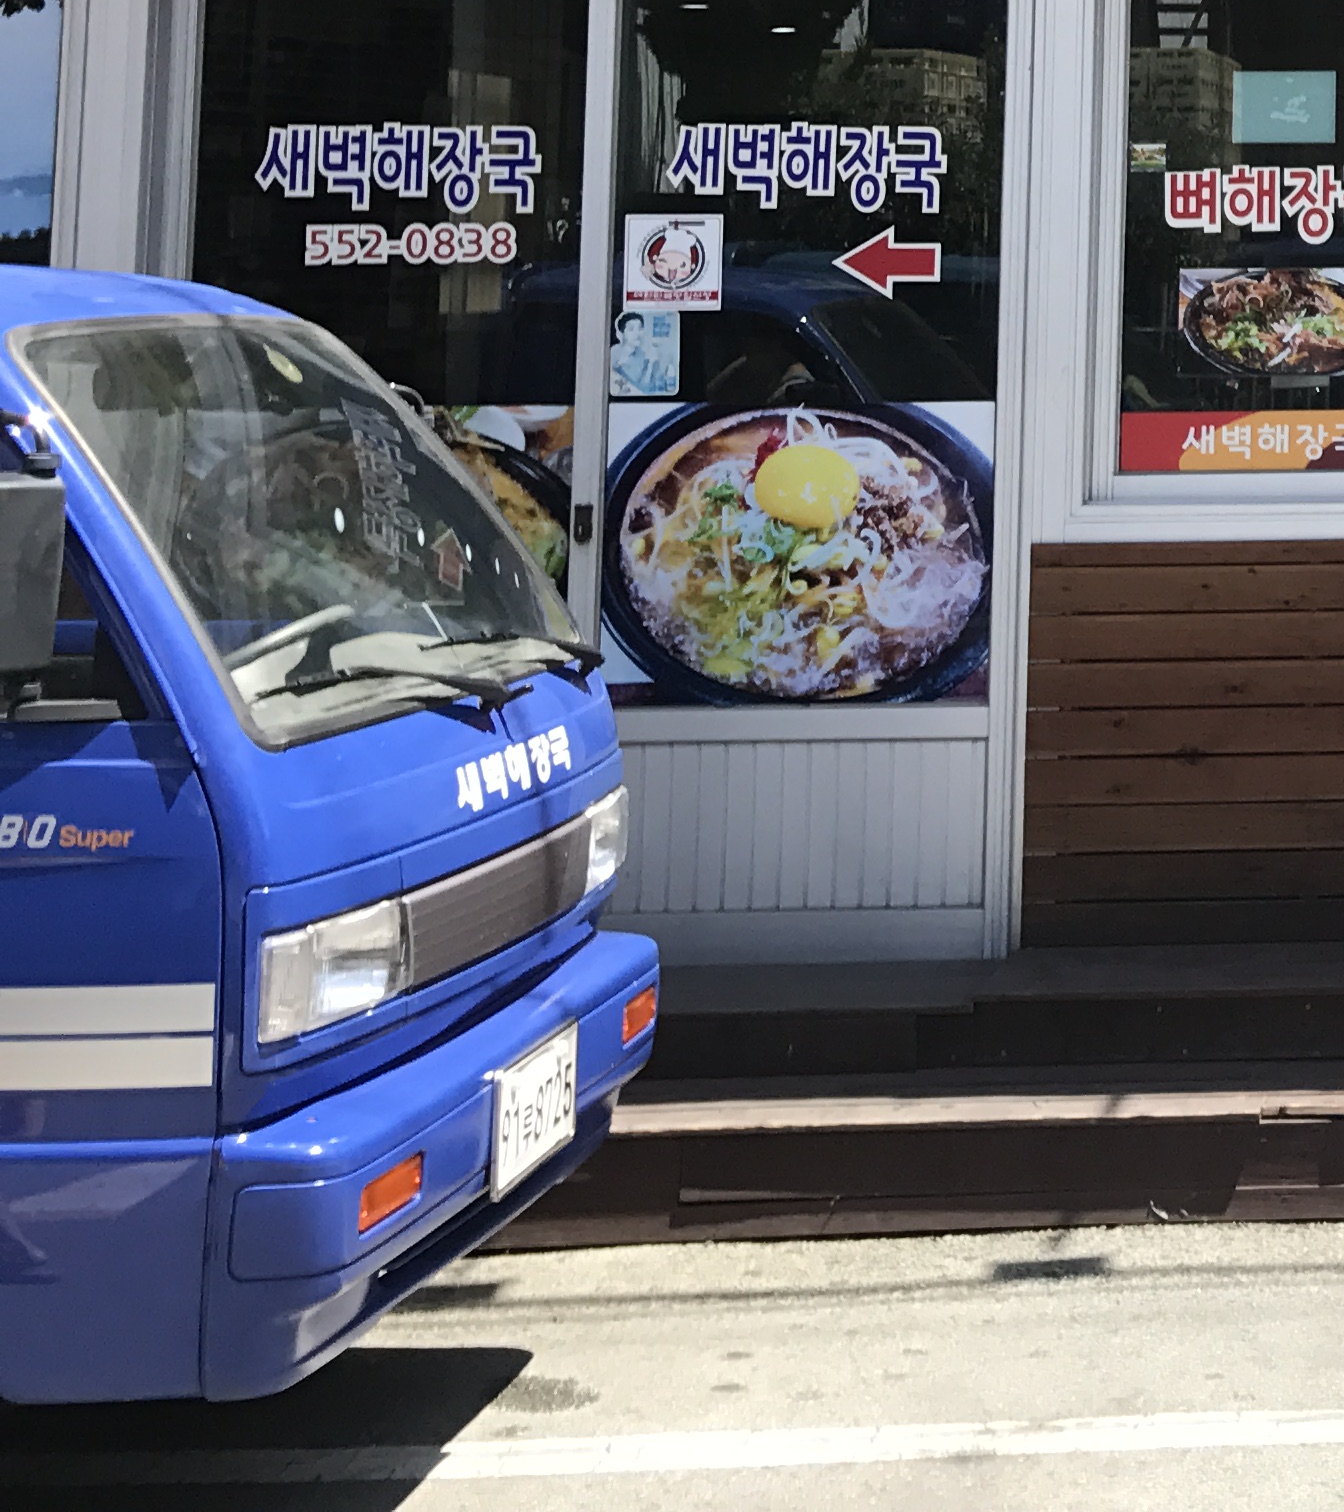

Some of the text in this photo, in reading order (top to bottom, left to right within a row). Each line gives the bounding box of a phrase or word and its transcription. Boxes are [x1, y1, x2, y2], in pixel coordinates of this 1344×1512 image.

[255, 121, 542, 213] 새벽해장국
[666, 122, 947, 214] 새벽해장국
[304, 221, 518, 267] 552-0838
[456, 725, 571, 812] 새벽해장국
[59, 824, 134, 852] Super
